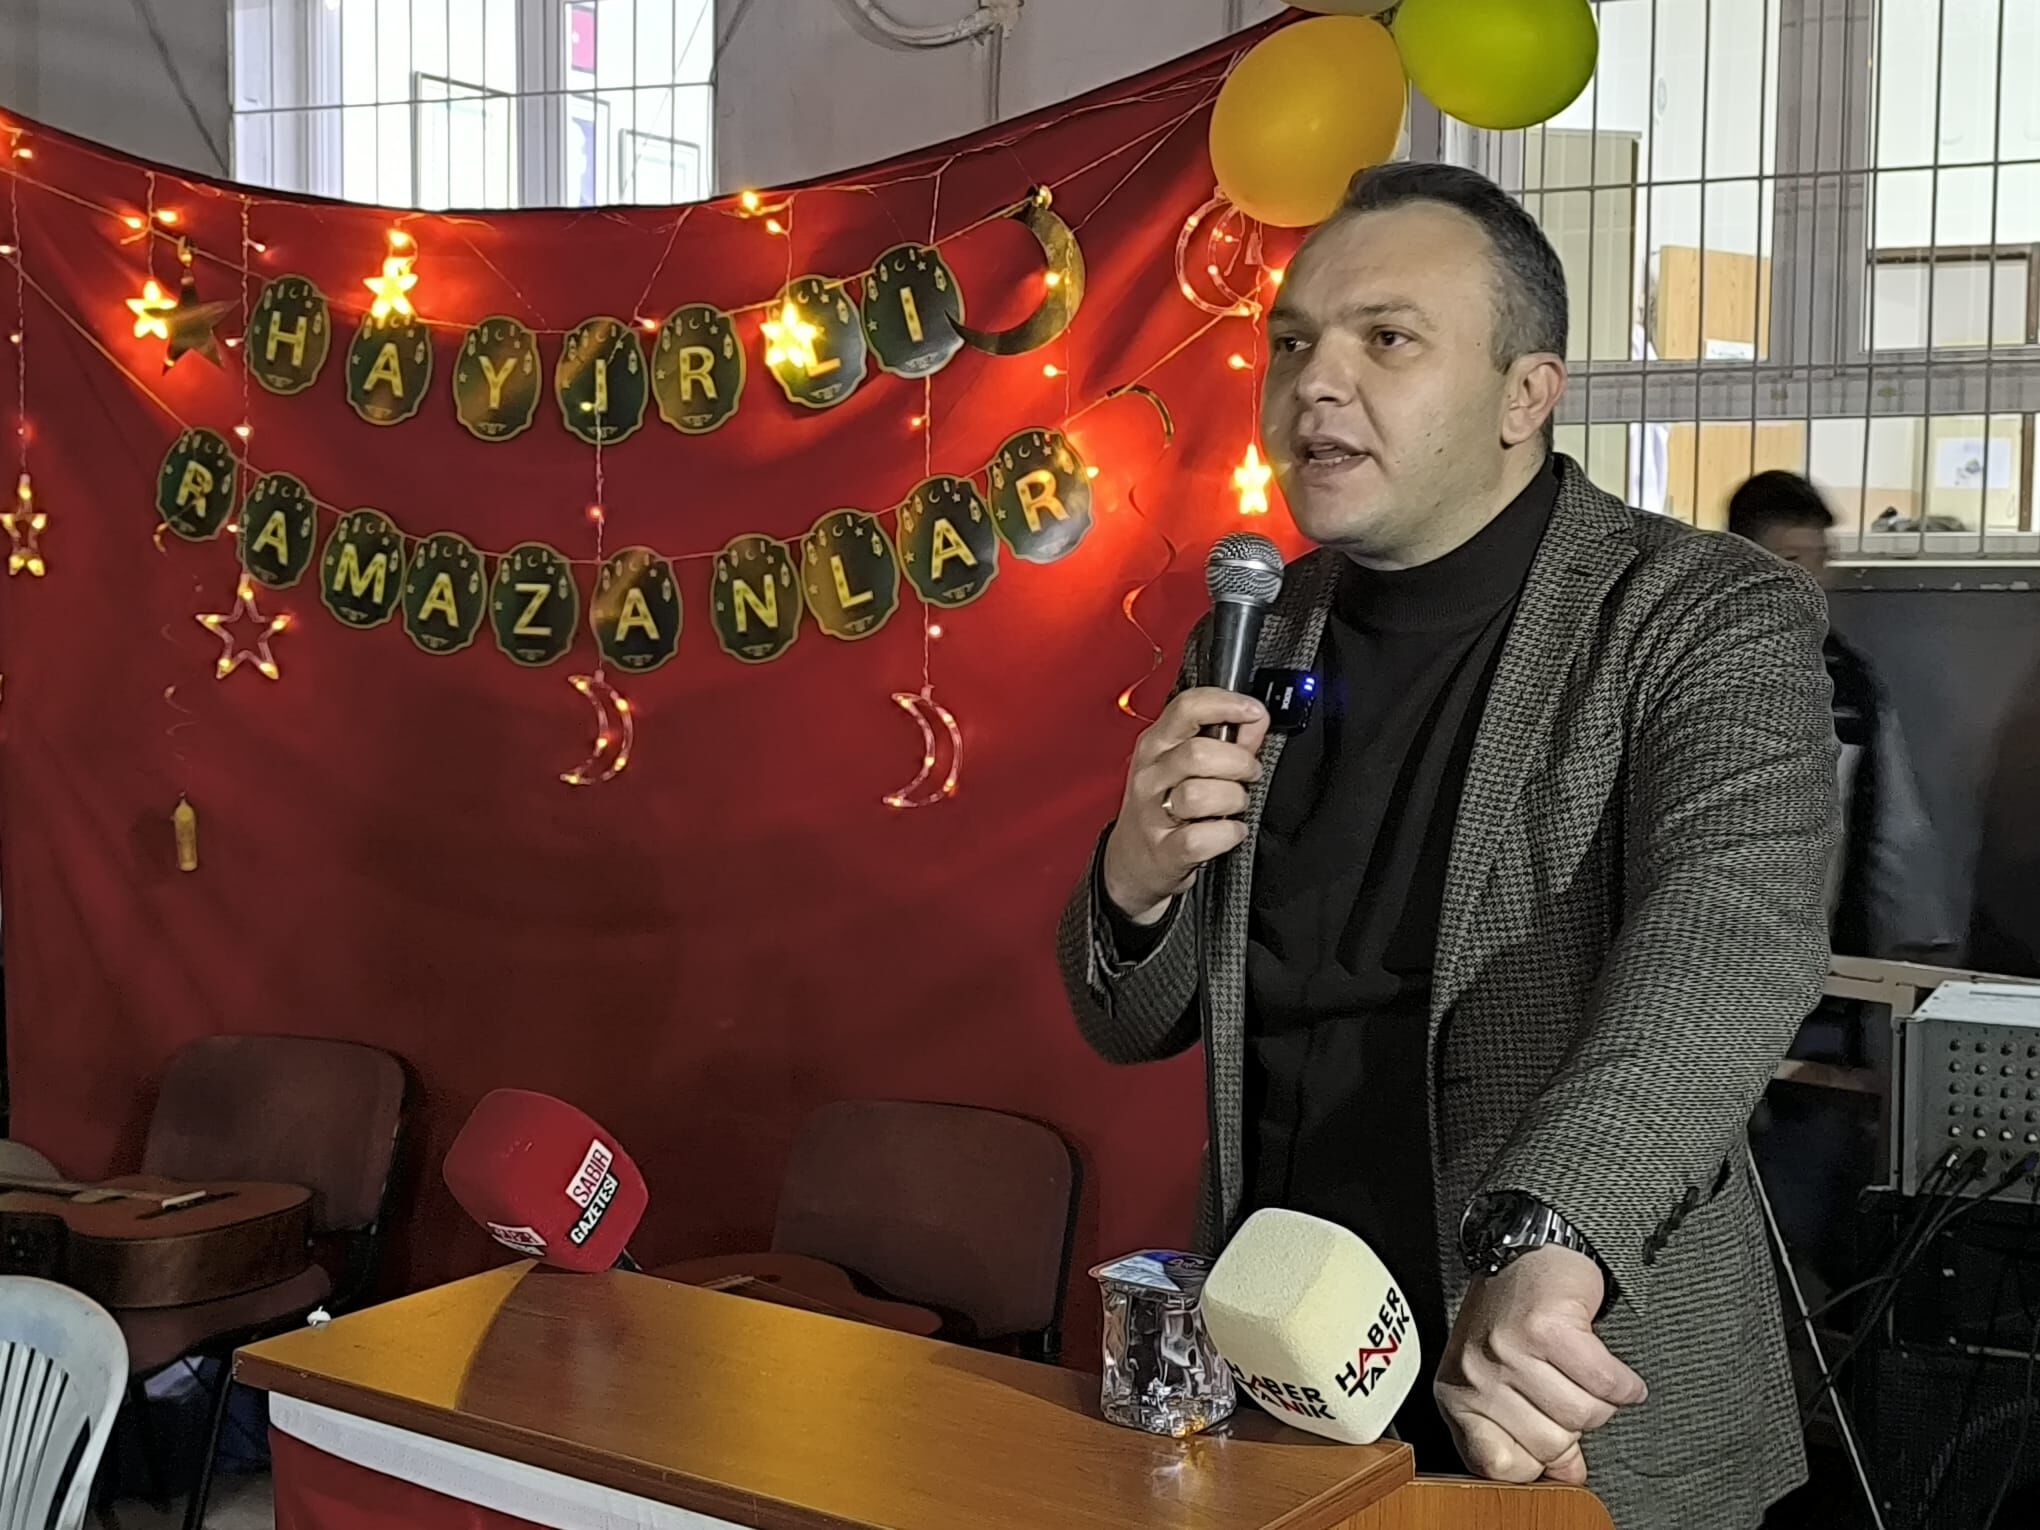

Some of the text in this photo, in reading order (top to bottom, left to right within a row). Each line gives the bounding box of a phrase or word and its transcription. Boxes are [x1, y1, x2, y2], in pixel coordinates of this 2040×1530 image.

[266, 287, 924, 412] HAYIRLI
[176, 461, 1070, 642] RAMAZANLAR
[572, 1148, 609, 1204] SABIR
[1335, 1287, 1400, 1392] HABER
